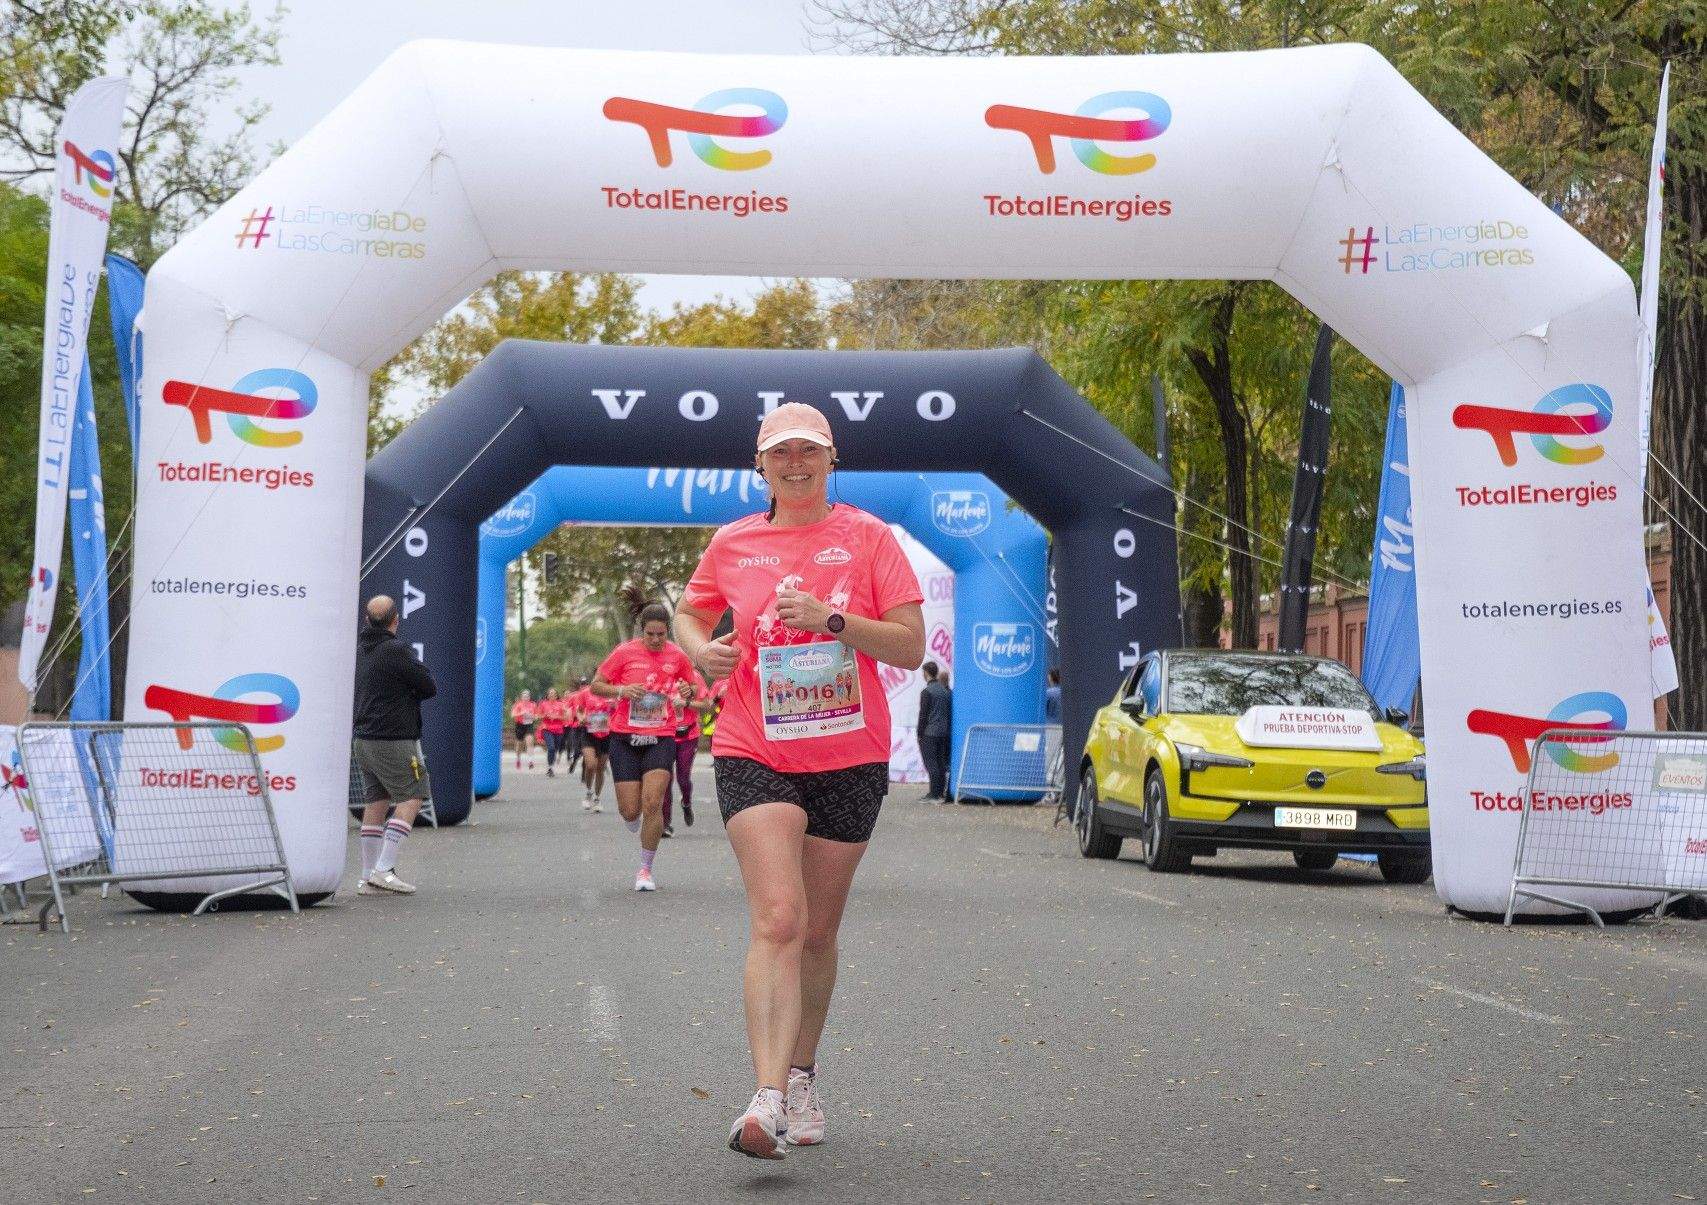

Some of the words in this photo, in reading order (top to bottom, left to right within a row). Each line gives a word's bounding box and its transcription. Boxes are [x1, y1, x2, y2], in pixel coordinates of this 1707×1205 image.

[602, 187, 788, 217] TotalEnergies
[984, 194, 1172, 221] TotalEnergies
[277, 228, 426, 260] LasCarreras
[1385, 248, 1535, 272] LasCarreras
[158, 462, 314, 489] TotalEnergies
[1456, 482, 1617, 508] TotalEnergies
[738, 556, 780, 568] OYSHO
[151, 578, 307, 600] totalenergies.es
[1462, 599, 1623, 619] totalenergies.es
[1263, 723, 1296, 734] PRUEBA
[1279, 712, 1345, 723] ATENCIÓN
[776, 725, 808, 735] OYSHO
[1470, 788, 1633, 815] TotaEnergies
[1285, 811, 1321, 825] 3898
